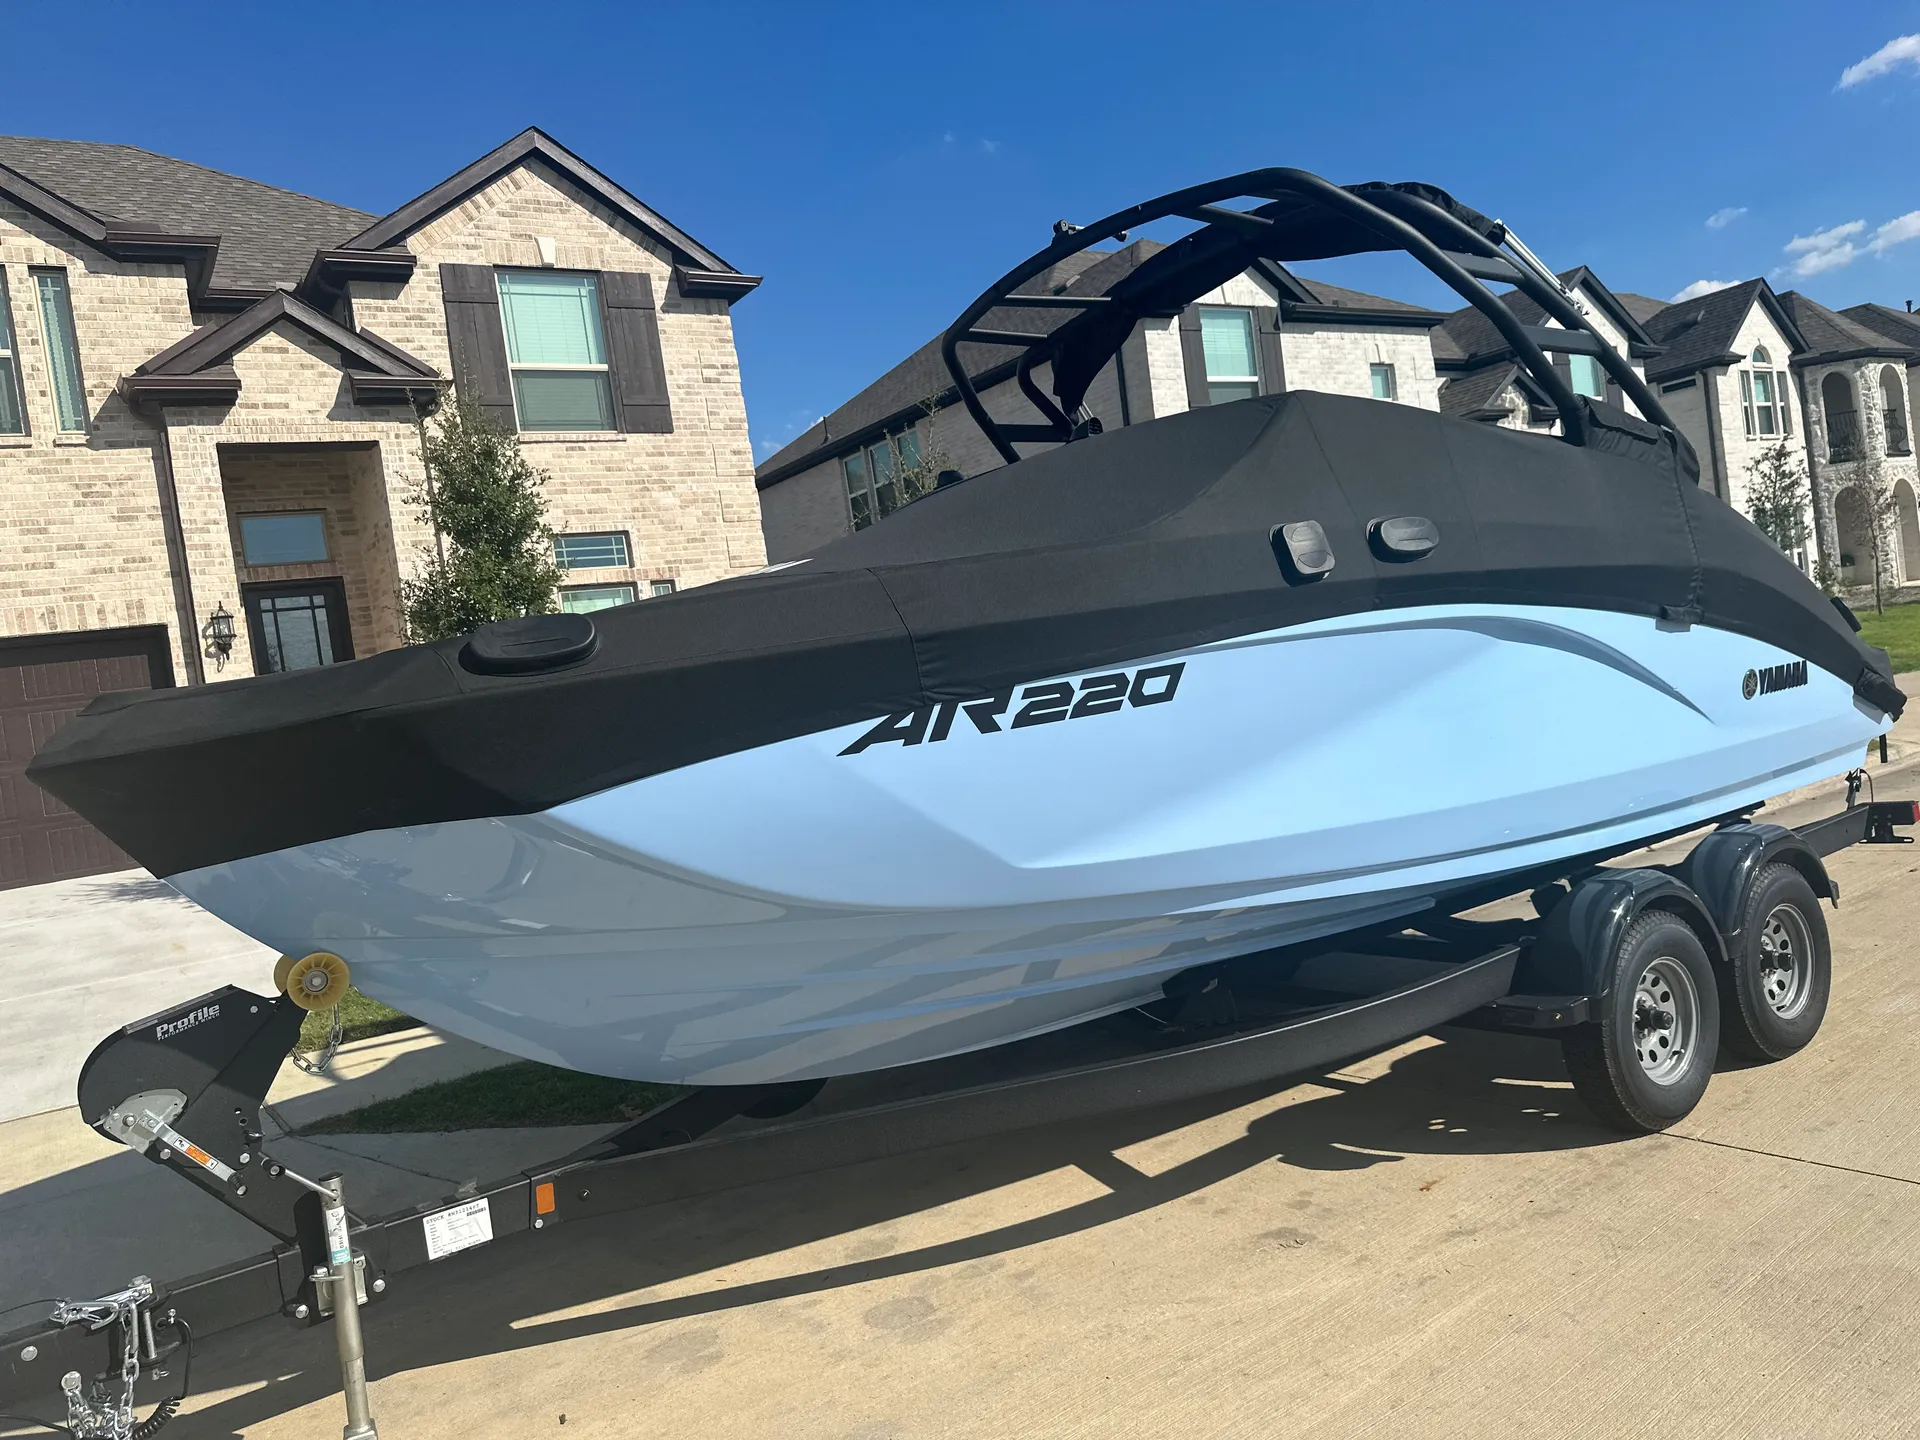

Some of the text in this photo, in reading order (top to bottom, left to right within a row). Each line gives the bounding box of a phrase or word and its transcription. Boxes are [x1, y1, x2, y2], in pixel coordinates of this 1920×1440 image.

[1759, 660, 1808, 696] YAMAHA
[836, 662, 1186, 756] AR220
[156, 1004, 220, 1038] Profile
[157, 1020, 199, 1041] PERFORMANCE
[426, 1215, 444, 1225] STOCK
